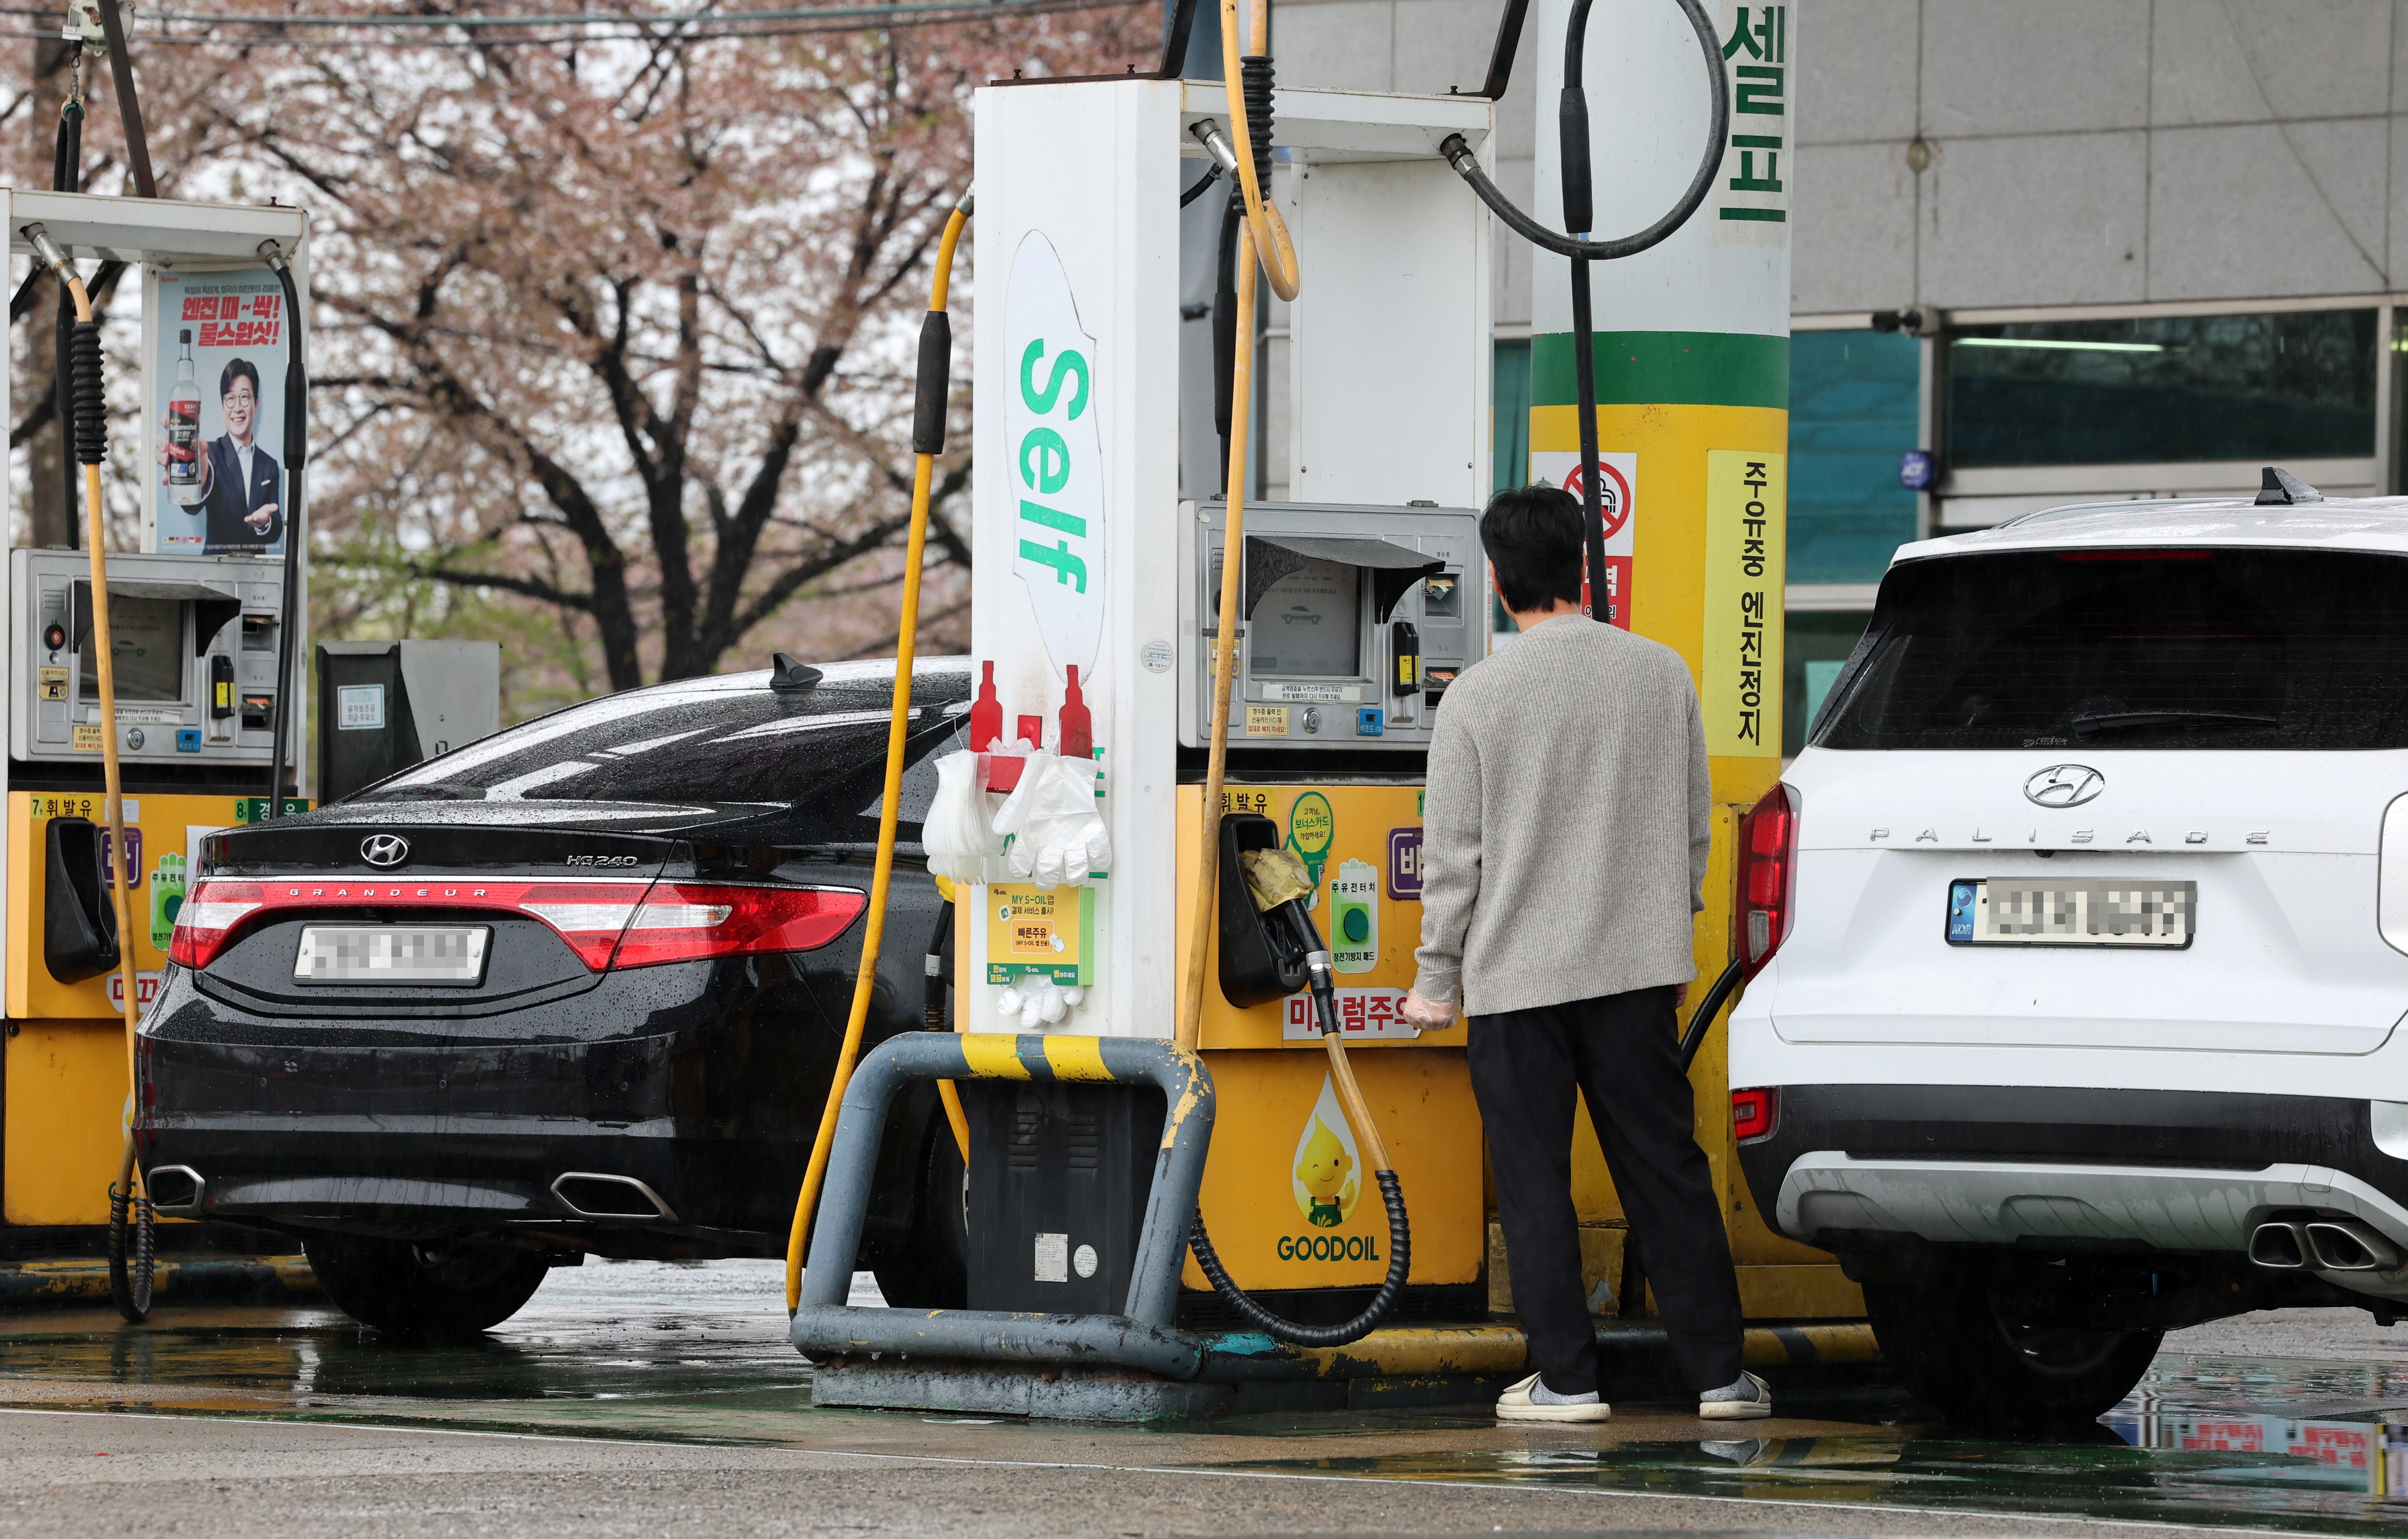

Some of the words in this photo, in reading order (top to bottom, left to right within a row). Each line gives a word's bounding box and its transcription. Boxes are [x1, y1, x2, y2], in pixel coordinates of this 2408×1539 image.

[1720, 5, 1786, 223] 셀프
[182, 296, 220, 320] 엔진
[198, 321, 280, 347] 불스원샷!
[1019, 338, 1089, 595] Self
[1742, 461, 1767, 577] 주유중
[1738, 591, 1764, 746] 엔진정지
[46, 798, 92, 817] 휘발유
[1296, 816, 1329, 830] 보너스카드
[1300, 832, 1326, 841] 가입하세요!
[1870, 827, 2270, 845] PALISADE
[1012, 895, 1023, 904] MY
[1018, 927, 1047, 939] 빠른주유
[1951, 923, 1972, 935] KOR
[1333, 952, 1361, 962] 정전기방지
[1363, 951, 1374, 961] 패드
[1277, 1236, 1379, 1261] GOODOIL
